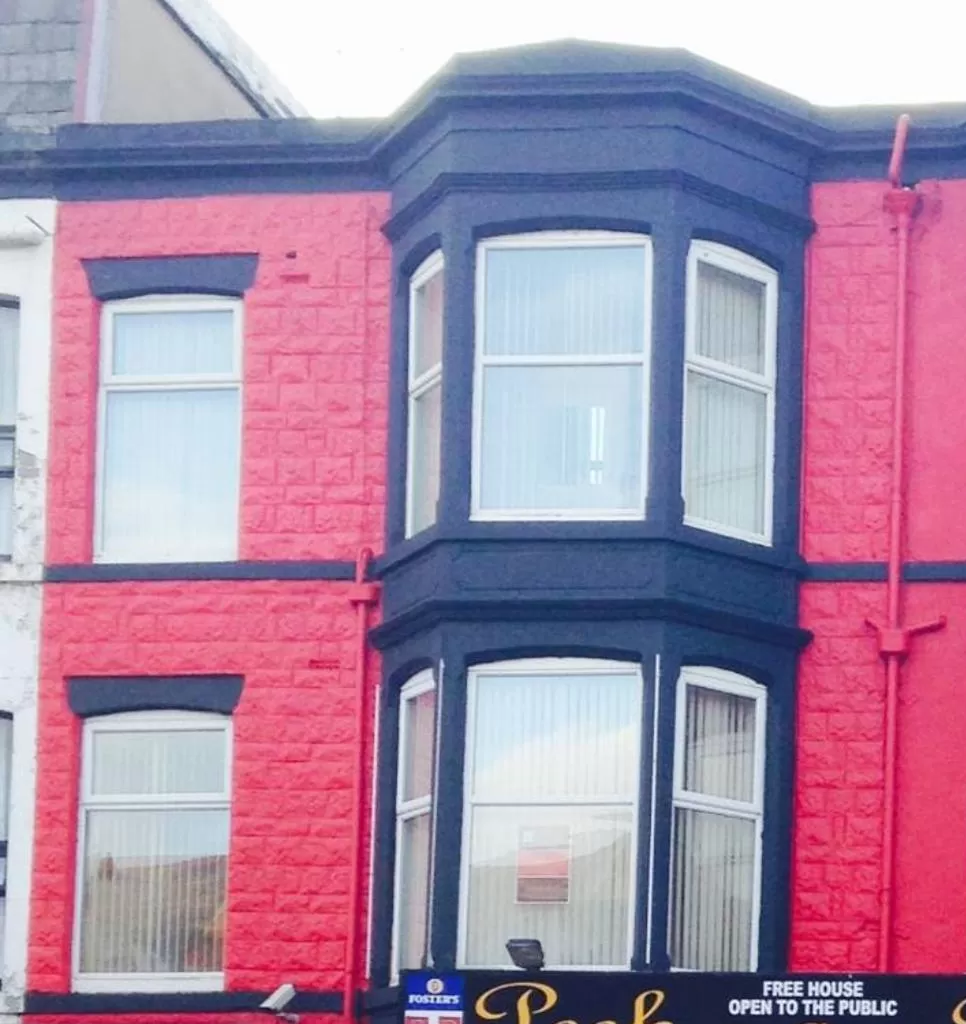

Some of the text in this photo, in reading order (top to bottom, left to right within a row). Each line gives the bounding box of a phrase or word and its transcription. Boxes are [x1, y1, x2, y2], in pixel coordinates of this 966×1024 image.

[763, 981, 863, 997] FREE HOUSE
[408, 995, 460, 1004] FOSTER'S
[728, 999, 898, 1016] OPEN TO THE PUBLIC
